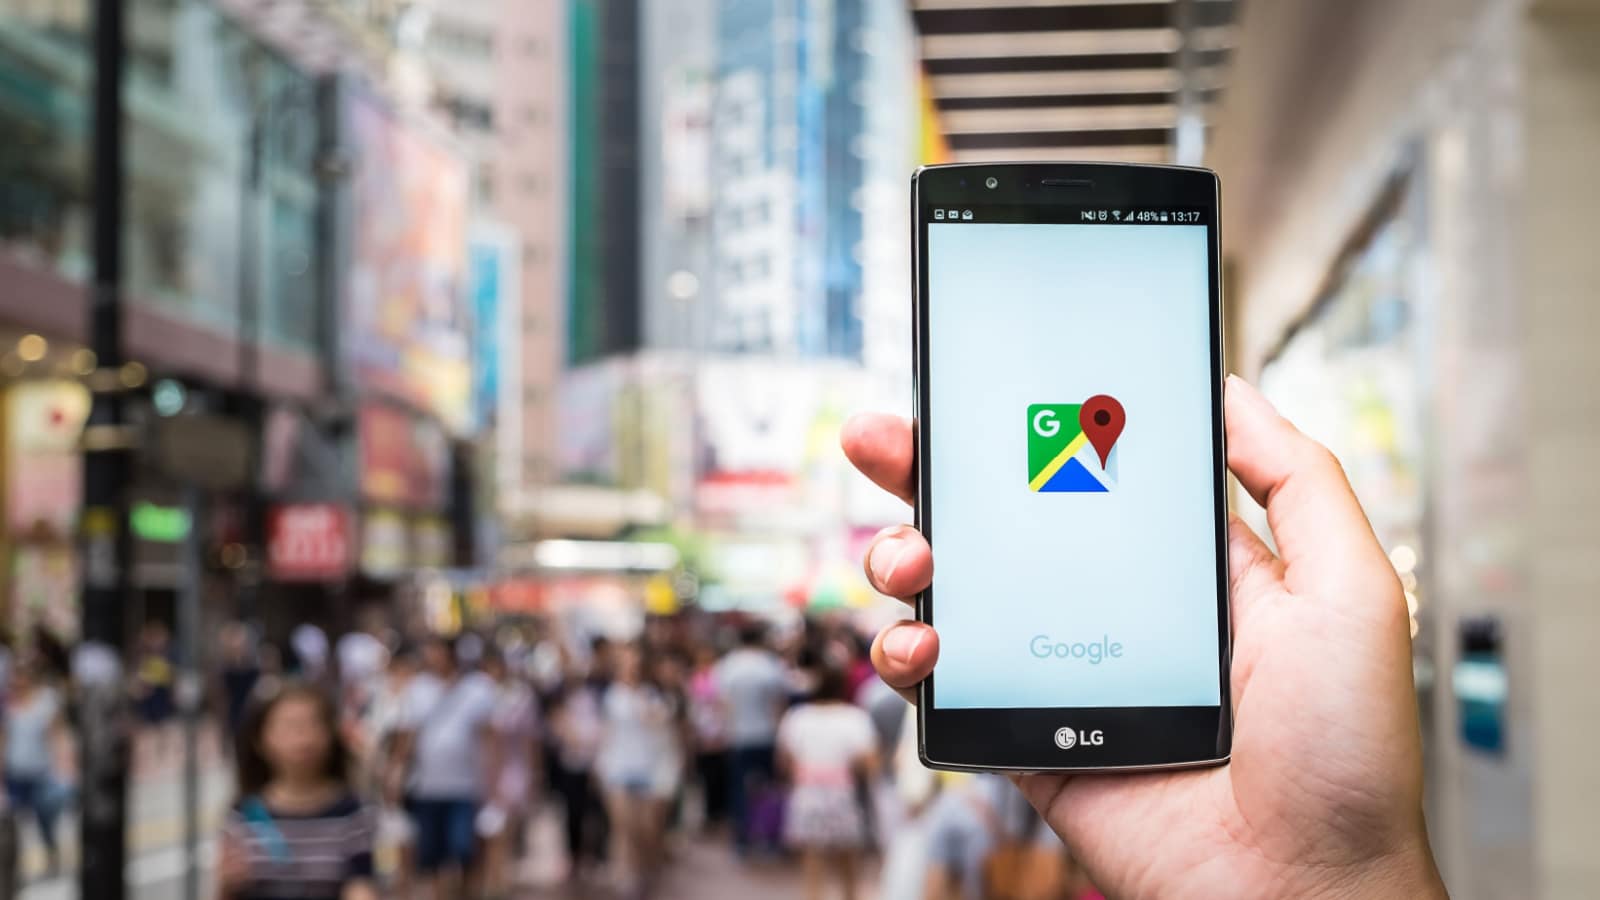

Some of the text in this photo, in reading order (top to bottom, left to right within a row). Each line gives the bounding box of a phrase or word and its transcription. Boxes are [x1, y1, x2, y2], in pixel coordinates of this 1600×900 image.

[1136, 211, 1200, 222] 48% 13:17
[1033, 409, 1061, 438] G
[1029, 634, 1123, 665] Google
[1080, 730, 1104, 745] LG
